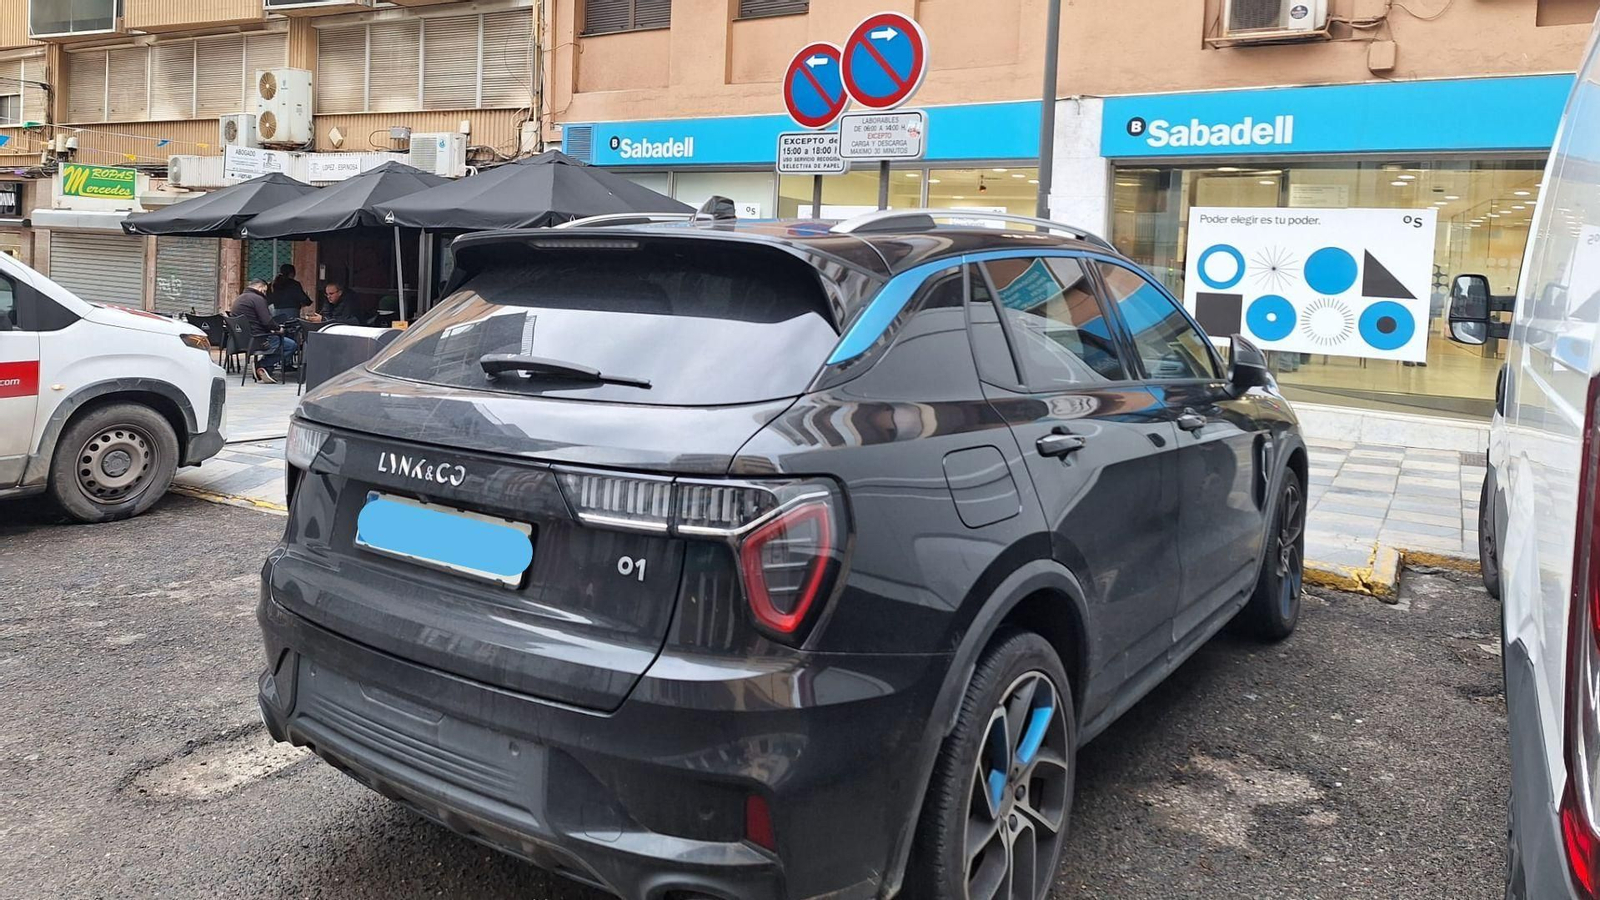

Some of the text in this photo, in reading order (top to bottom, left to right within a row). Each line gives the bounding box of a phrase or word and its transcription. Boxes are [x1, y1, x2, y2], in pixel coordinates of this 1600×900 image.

[1146, 115, 1294, 147] Sabadell
[620, 137, 693, 158] Sabadell
[63, 166, 133, 197] Mercedes
[92, 168, 133, 179] ROPAS
[1200, 214, 1228, 224] Poder
[1230, 215, 1258, 226] elegir
[1275, 216, 1286, 224] tu
[1288, 216, 1321, 226] poder.
